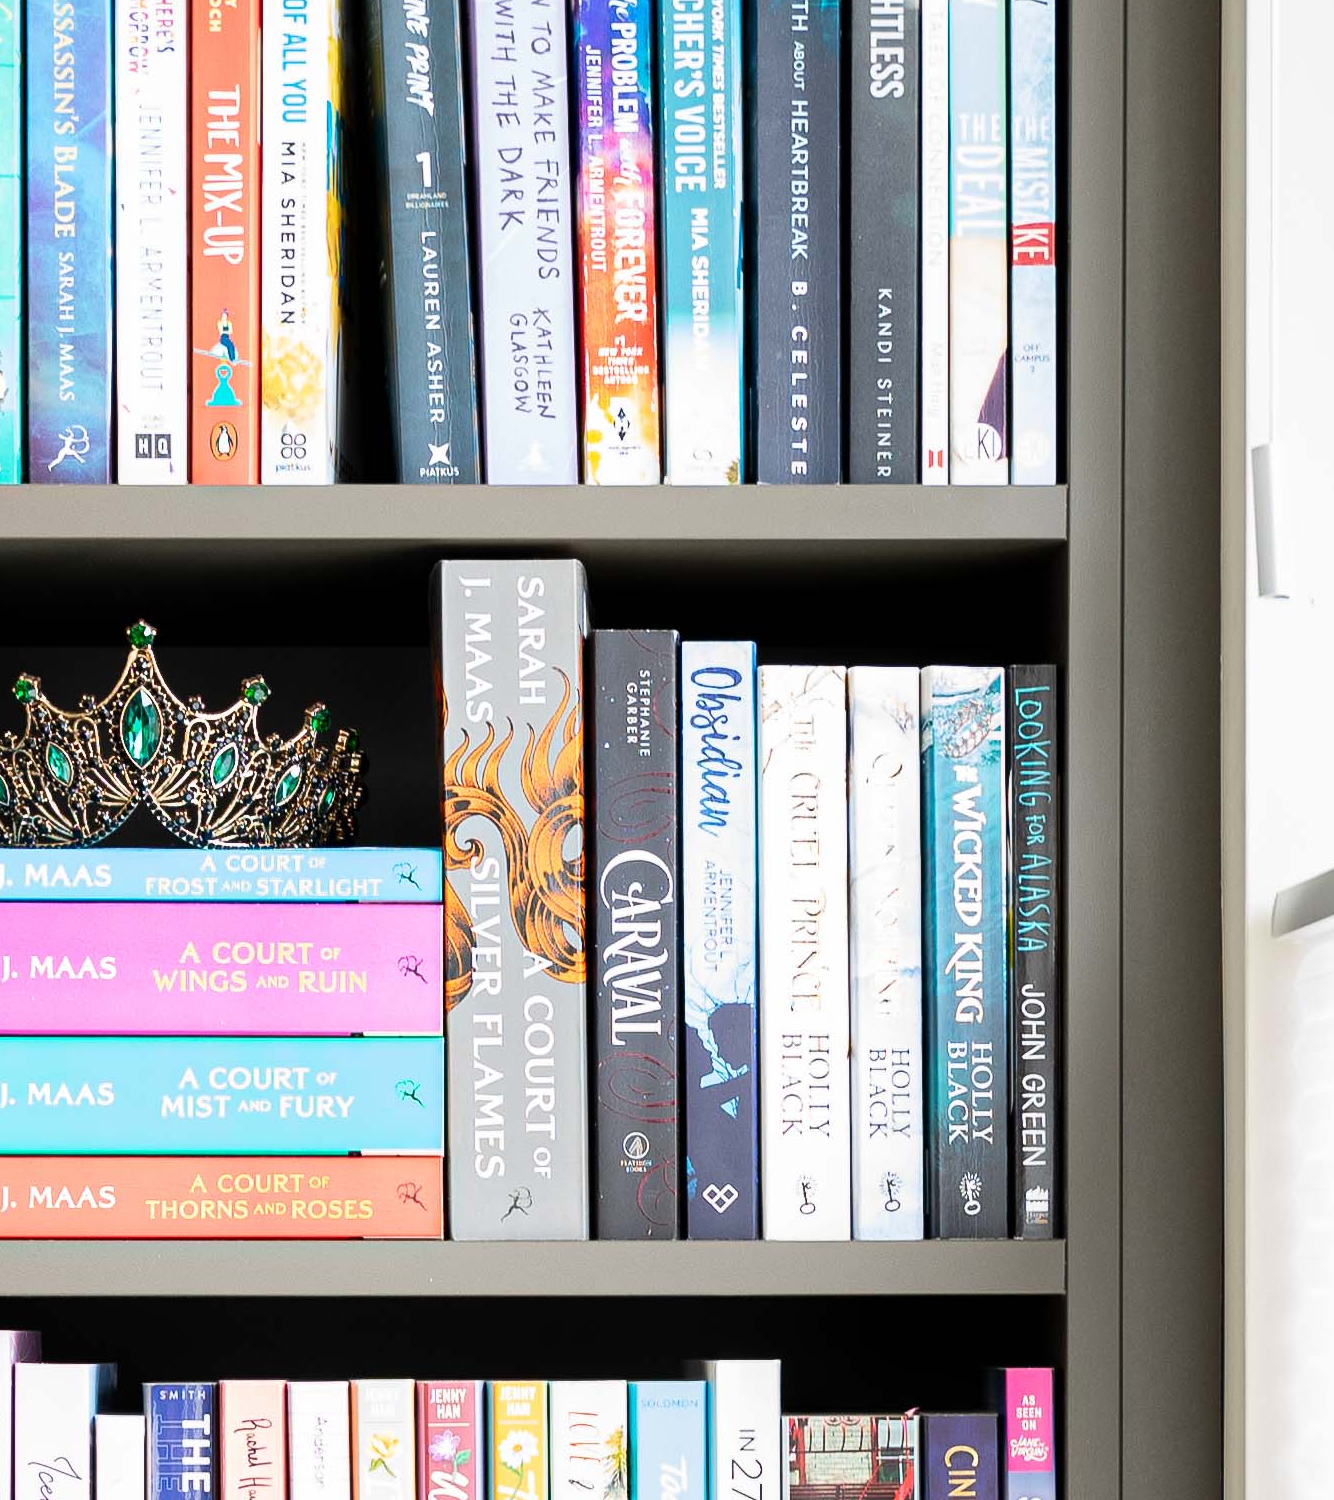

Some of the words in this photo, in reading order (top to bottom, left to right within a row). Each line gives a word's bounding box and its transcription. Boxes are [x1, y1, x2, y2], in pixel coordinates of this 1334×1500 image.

[284, 34, 306, 71] ALL
[206, 85, 241, 149] THE
[284, 80, 307, 123] YOU
[675, 106, 706, 192] VOICE
[202, 155, 242, 264] MIX-UP
[421, 232, 441, 330] LAUREN
[879, 289, 892, 363] KANDI
[427, 343, 445, 423] ASHER
[877, 379, 892, 477] STEINER
[689, 667, 742, 835] Obsidian
[470, 857, 500, 997] SILVER
[522, 949, 552, 976] A
[601, 849, 676, 1045] CARAVAL
[525, 996, 556, 1141] COURT
[1021, 984, 1046, 1060] JOHN
[473, 1012, 504, 1178] FLAMES
[947, 1041, 969, 1145] BLACK
[970, 1042, 993, 1145] HOLLY
[1021, 1073, 1045, 1165] GREEN
[1, 1186, 20, 1210] J.
[32, 1185, 116, 1208] MAAS
